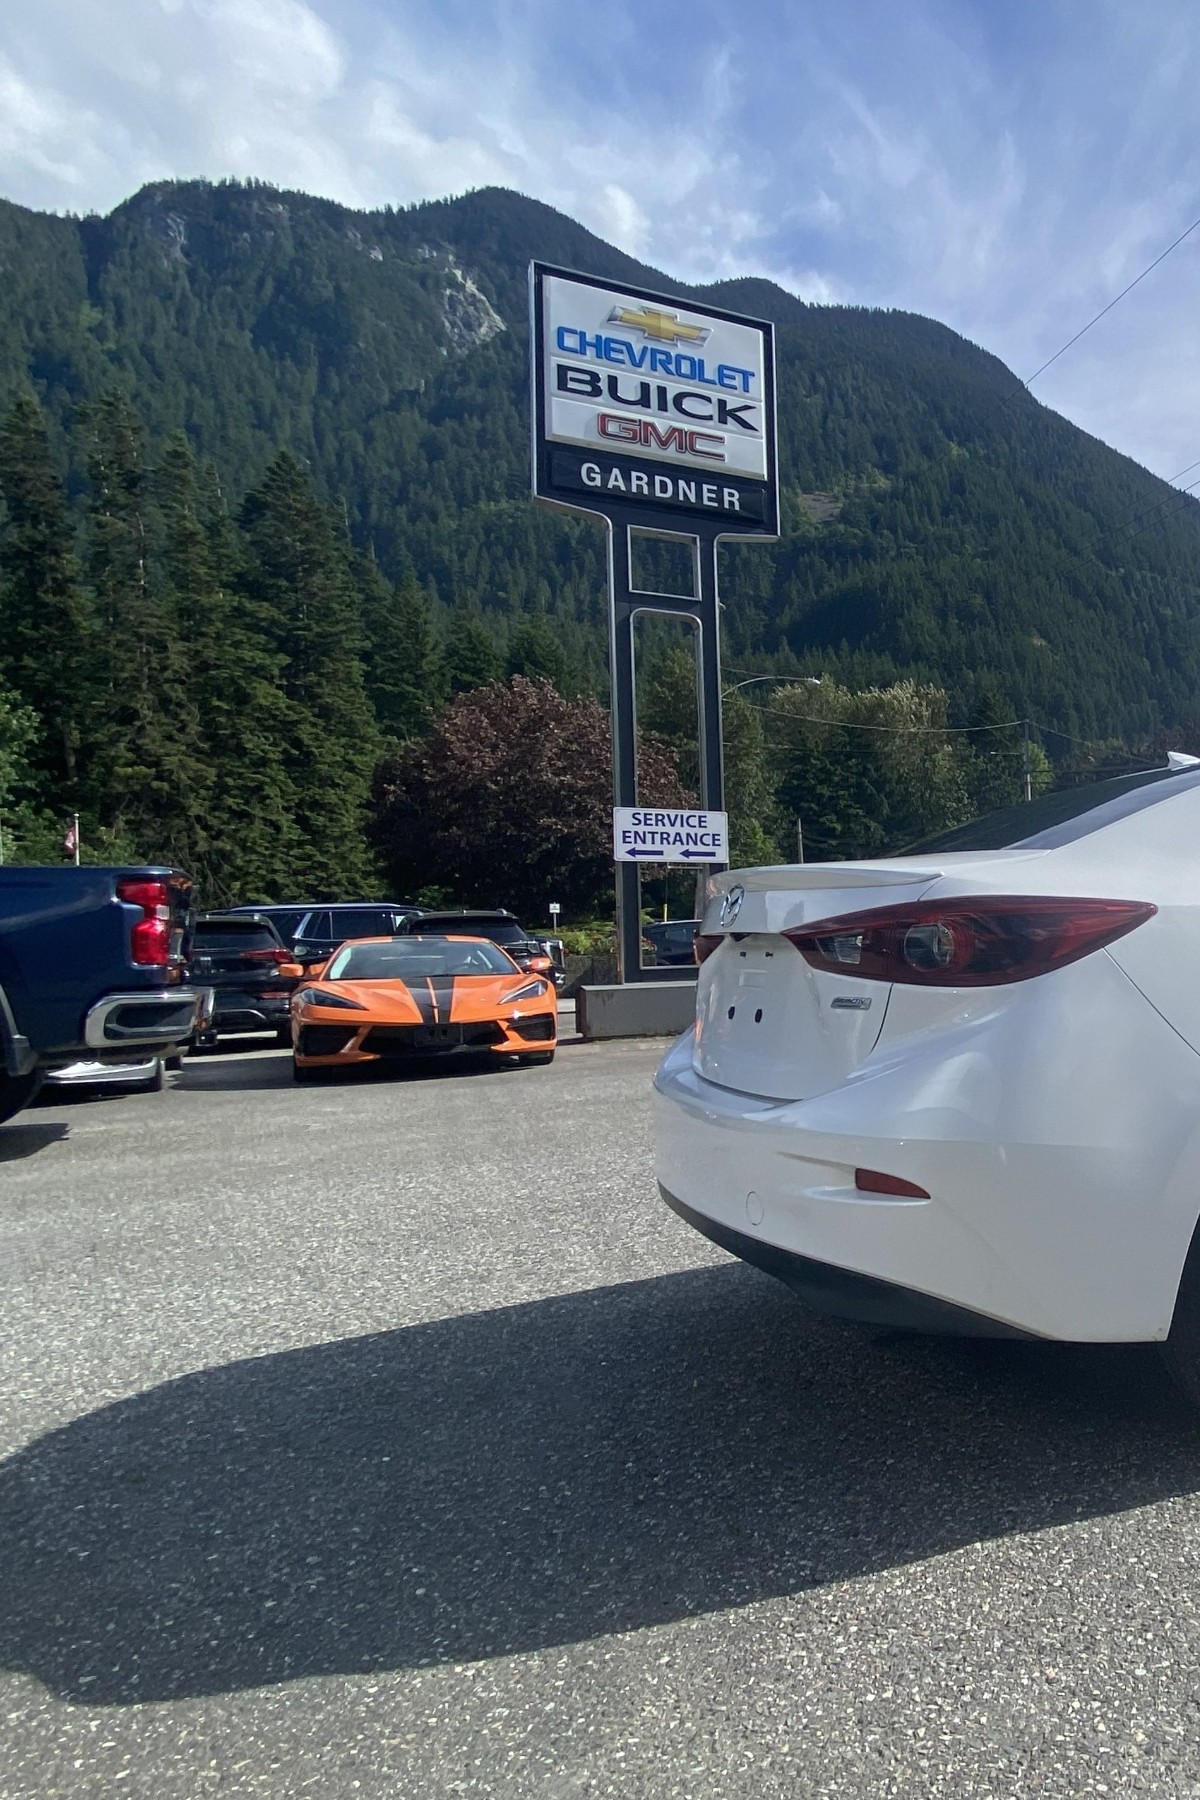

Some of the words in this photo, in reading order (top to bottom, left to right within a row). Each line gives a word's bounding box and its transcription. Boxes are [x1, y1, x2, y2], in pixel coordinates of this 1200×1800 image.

[557, 326, 755, 392] CHEVROLET
[556, 363, 759, 432] BUICK
[598, 413, 726, 462] GMC
[581, 463, 740, 510] GARDNER
[622, 830, 721, 847] ENTRANCE
[632, 812, 707, 828] SERVICE
